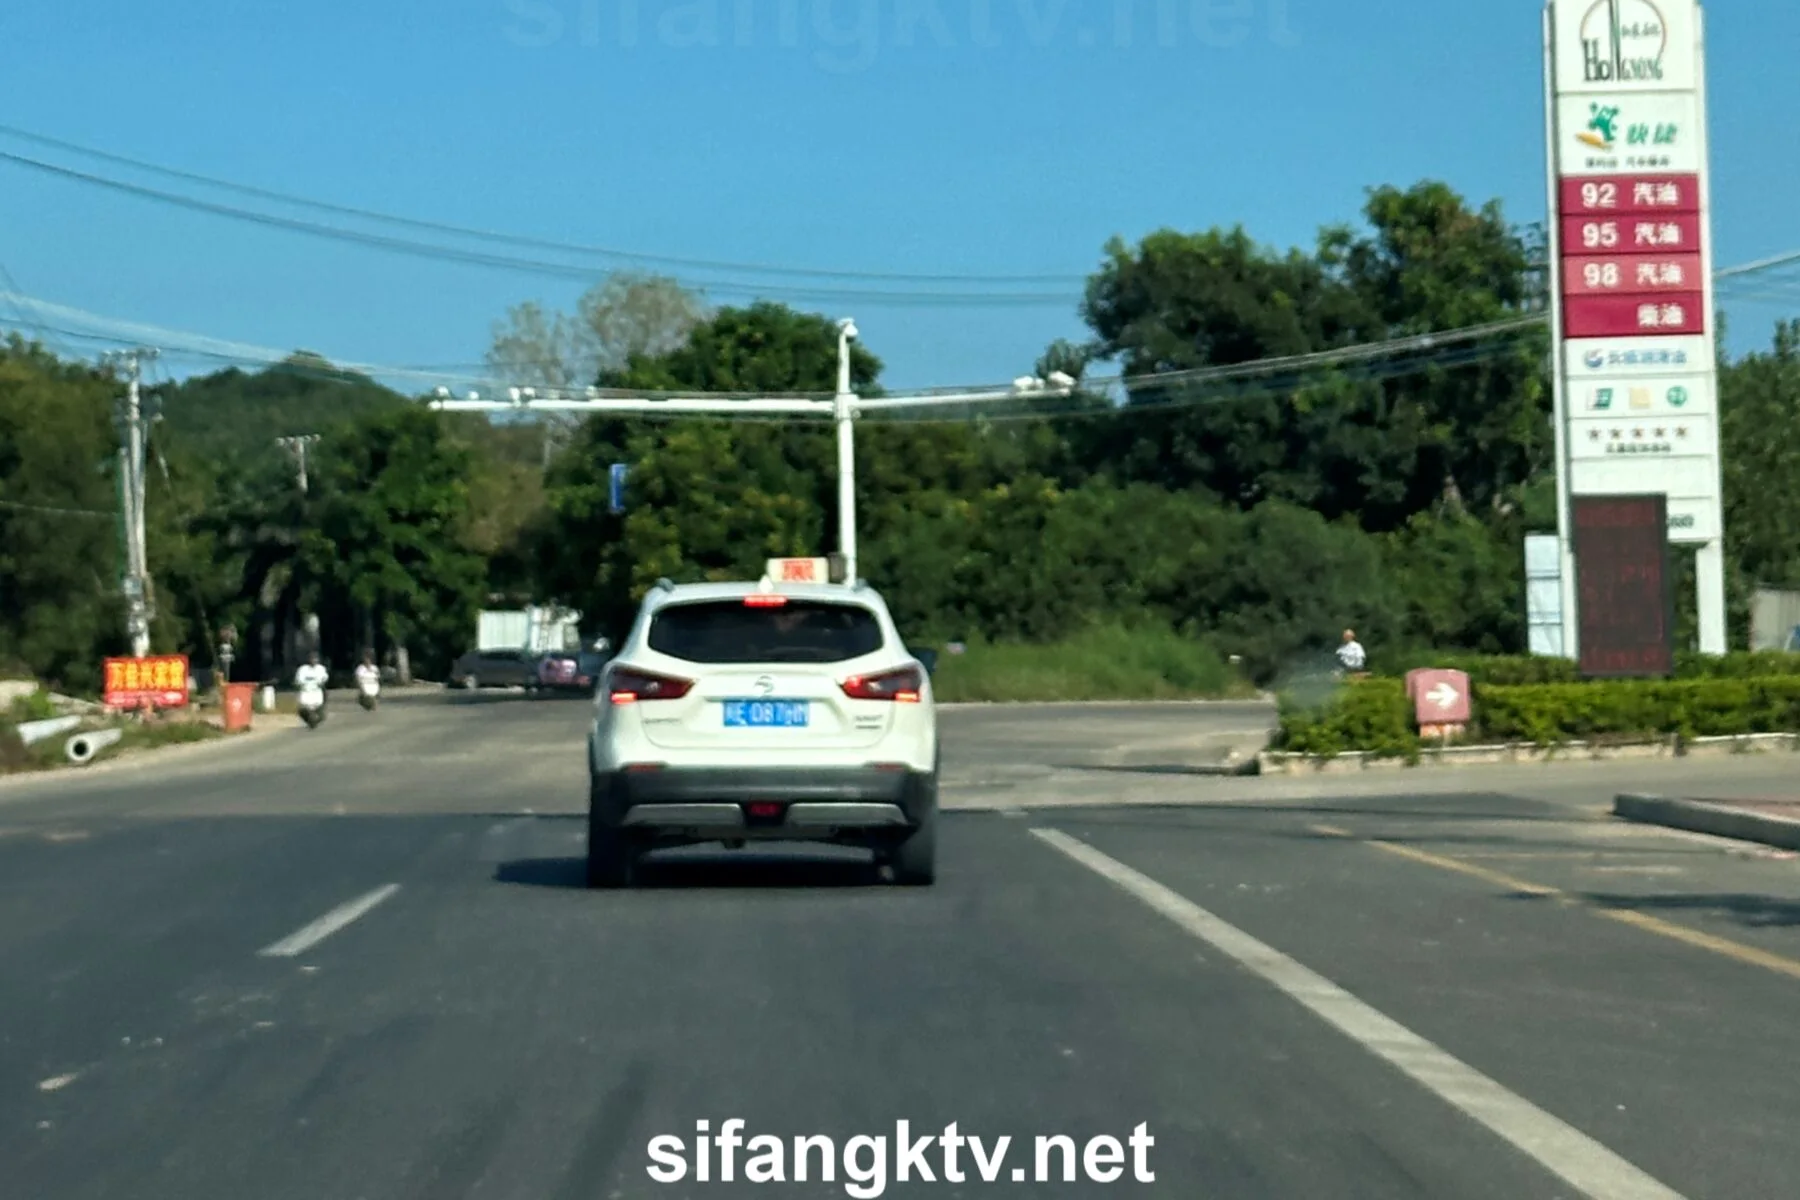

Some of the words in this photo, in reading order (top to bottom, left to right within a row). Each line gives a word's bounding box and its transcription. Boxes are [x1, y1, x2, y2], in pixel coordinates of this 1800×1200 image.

[1581, 182, 1617, 208] 92
[1633, 181, 1679, 206] 汽油
[1582, 222, 1618, 248] 95
[1635, 222, 1682, 246] 汽油
[1583, 262, 1621, 288] 98
[1635, 260, 1684, 286] 汽油
